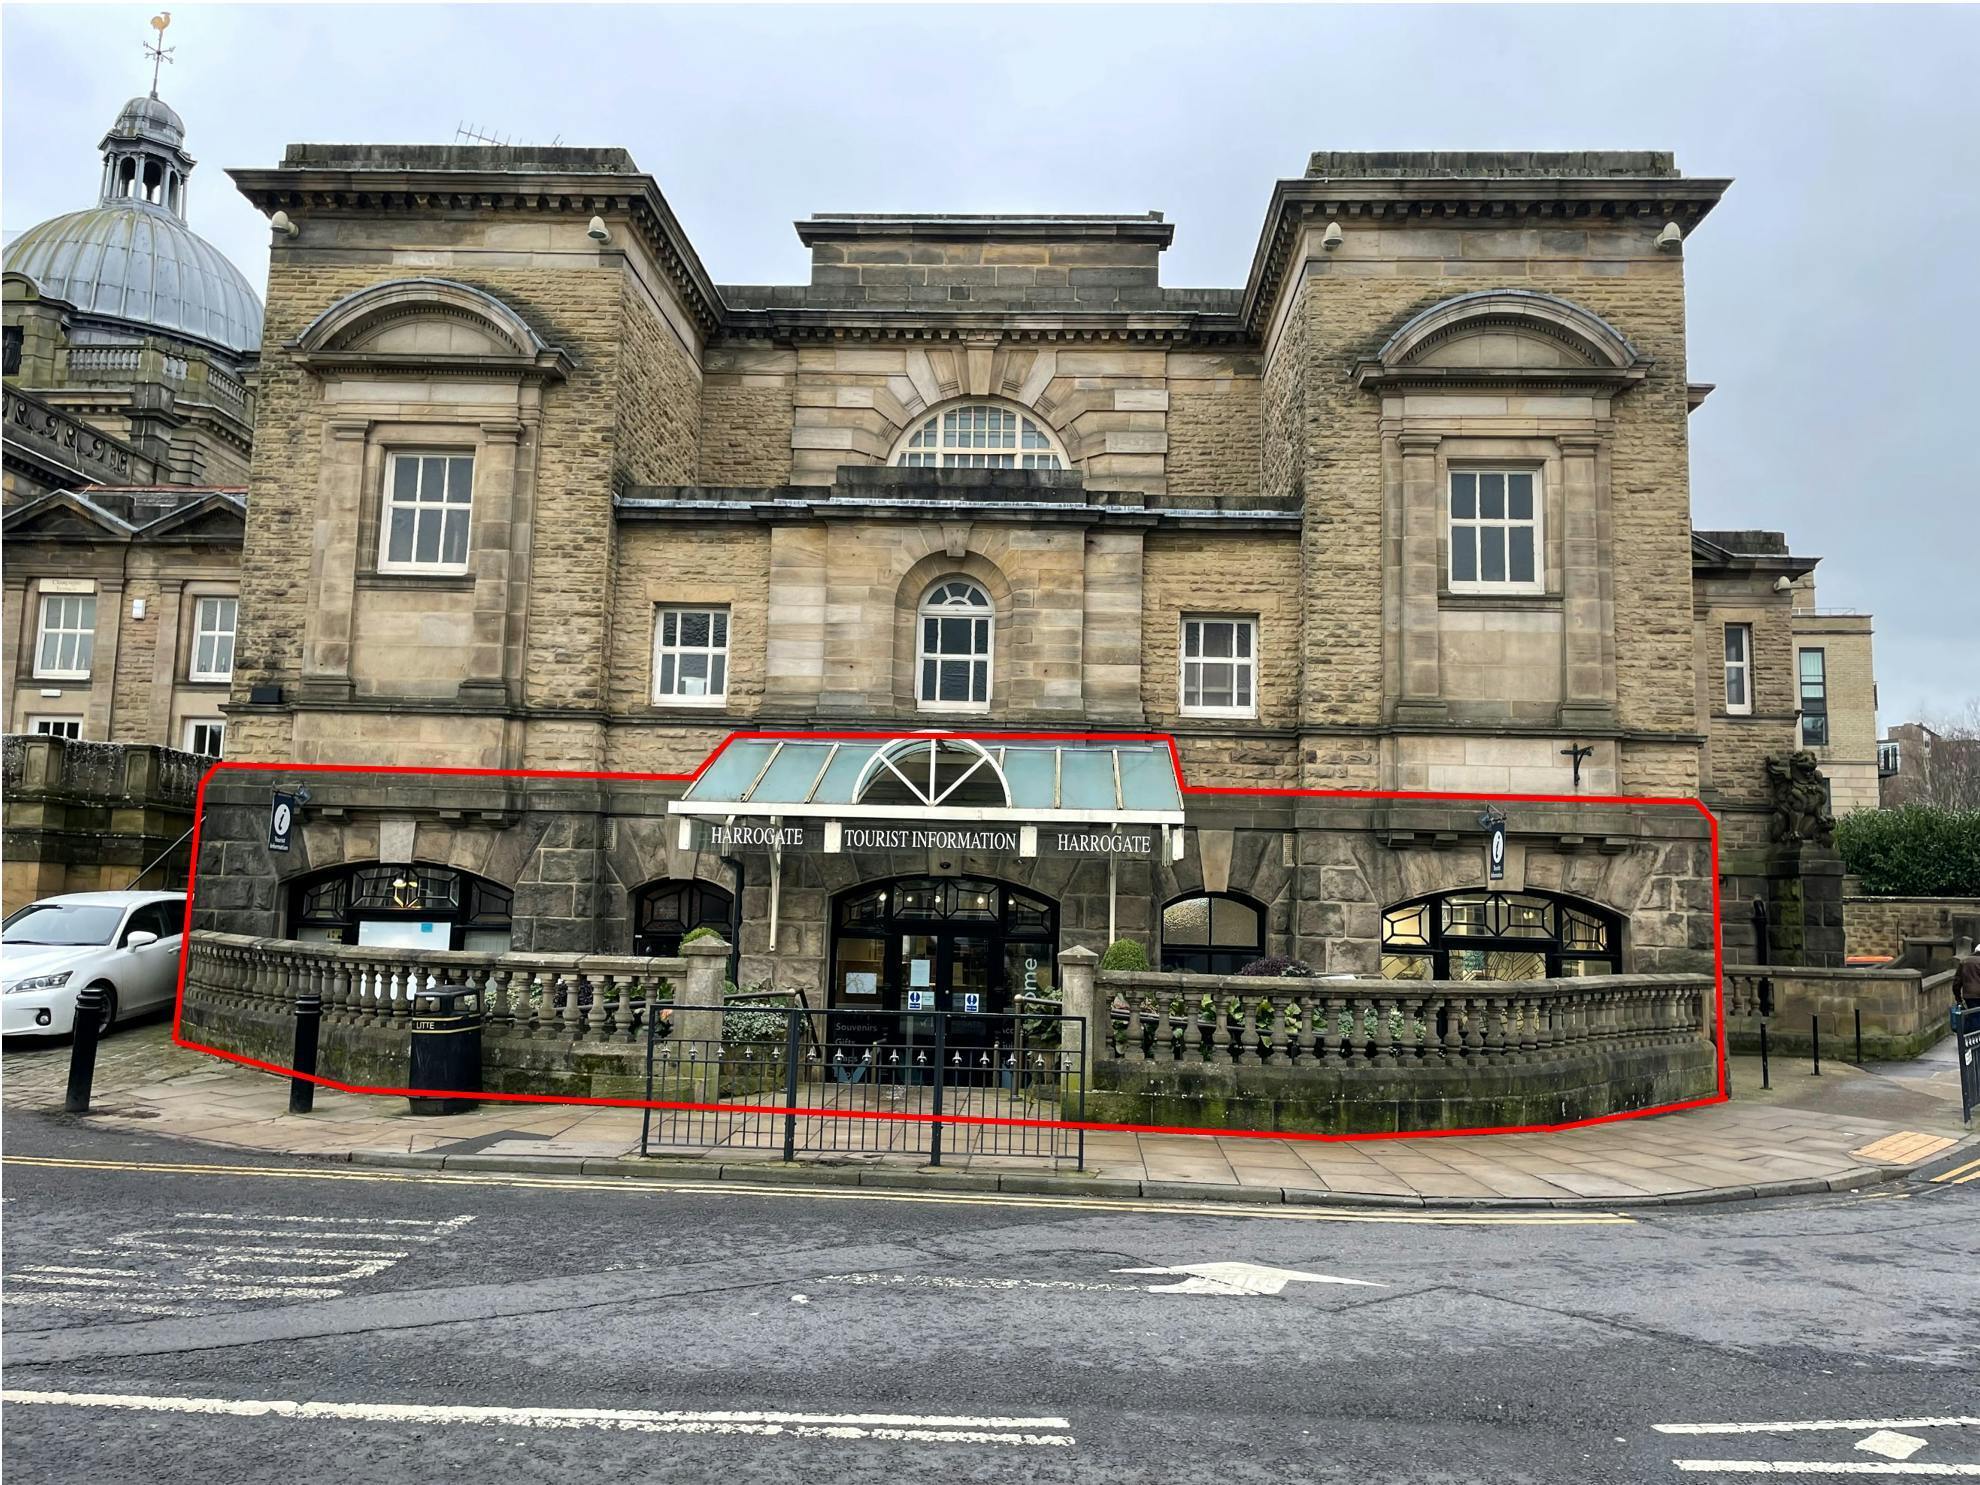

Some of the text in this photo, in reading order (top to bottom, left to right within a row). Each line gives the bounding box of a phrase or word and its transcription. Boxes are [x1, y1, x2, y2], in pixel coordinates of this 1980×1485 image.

[711, 826, 804, 846] HARROGATE
[844, 829, 1017, 850] TOURIST INFORMATION
[1058, 833, 1151, 853] HARROGATE
[835, 1022, 878, 1032] Souvenirs
